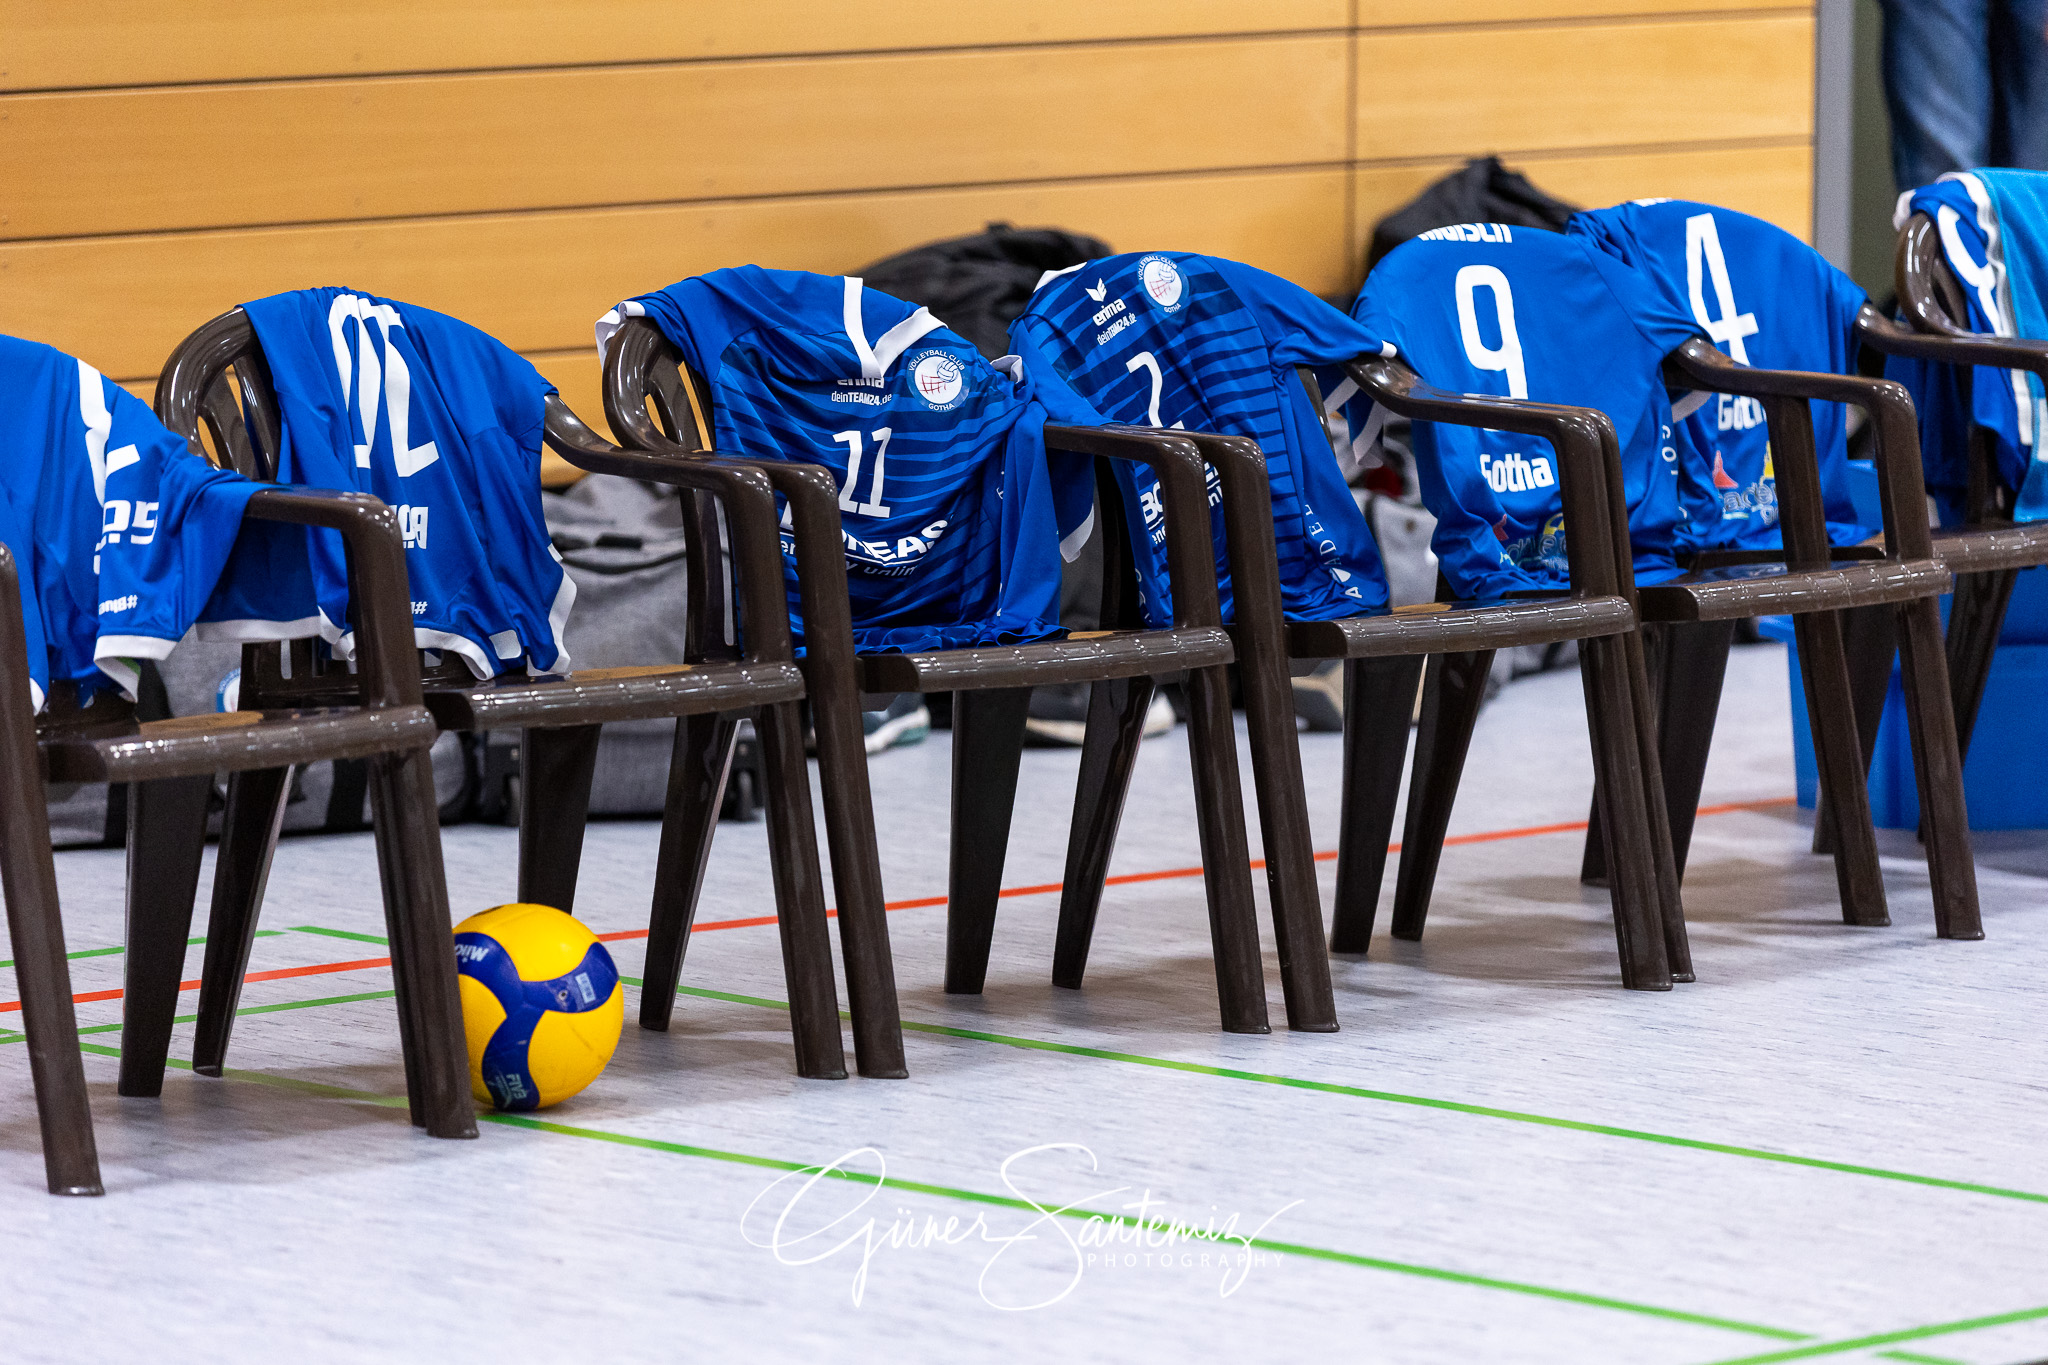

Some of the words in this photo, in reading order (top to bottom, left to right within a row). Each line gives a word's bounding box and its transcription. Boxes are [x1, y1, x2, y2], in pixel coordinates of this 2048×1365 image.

[1138, 256, 1160, 280] VOLLEYBALL
[1161, 257, 1178, 269] CLUB
[1686, 212, 1759, 367] 4
[1092, 299, 1126, 327] erima
[1163, 303, 1181, 313] GOTHA
[908, 349, 948, 372] VOLLEYBALL
[948, 354, 966, 371] CLUB
[1455, 265, 1528, 432] 9
[831, 391, 892, 406] deinTEAM24.de
[928, 403, 955, 411] GOTHA
[832, 427, 892, 518] 11
[1480, 453, 1555, 492] Gotha
